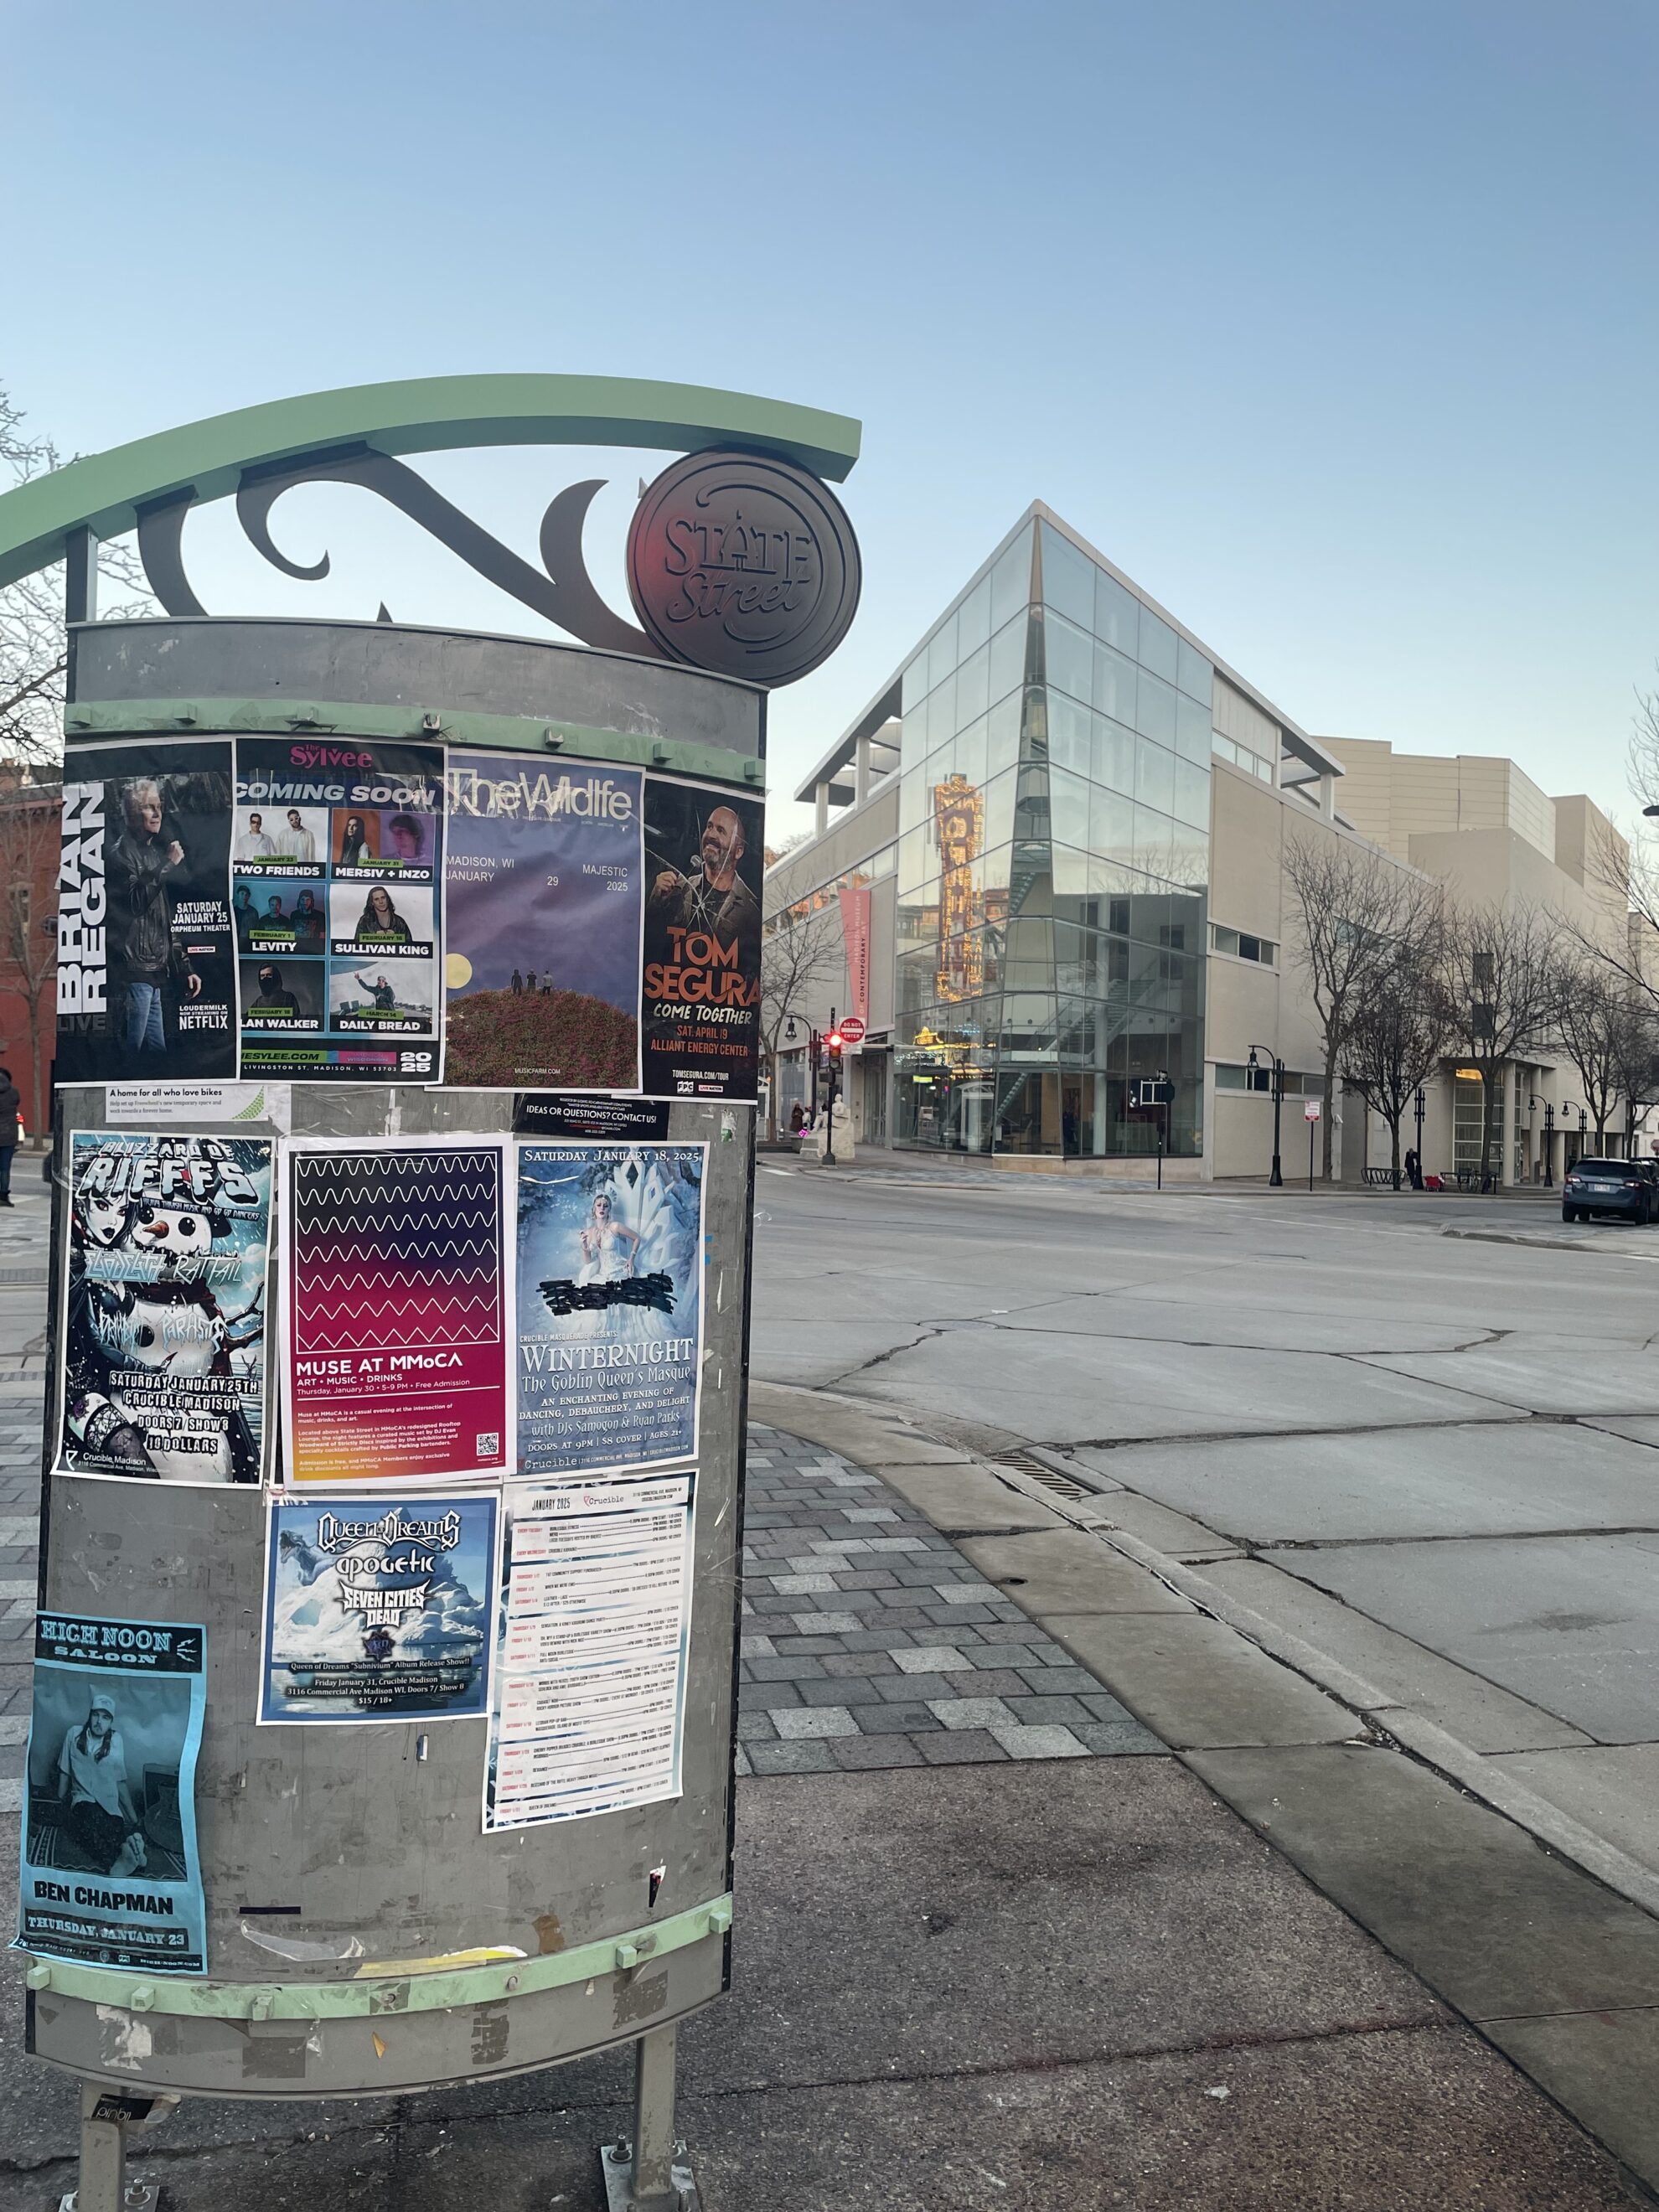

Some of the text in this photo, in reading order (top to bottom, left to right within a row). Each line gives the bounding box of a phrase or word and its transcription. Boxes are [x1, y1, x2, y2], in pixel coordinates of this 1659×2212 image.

[664, 510, 812, 585] STATE
[666, 573, 798, 623] Street
[290, 745, 373, 768] Sylvee
[236, 782, 436, 805] COMING SOON
[447, 855, 514, 868] MADISON, WI
[233, 866, 319, 876] TWO FRIENDS
[335, 868, 385, 877] MERSIV
[399, 870, 430, 879] INZO
[447, 871, 494, 882] JANUARY
[583, 865, 628, 877] MAJESTIC
[547, 876, 559, 886] 29
[607, 881, 628, 892] 2025
[57, 784, 81, 1014] BRIAN
[80, 783, 106, 1013] REGAN
[177, 902, 222, 913] SATURDAY
[172, 912, 228, 924] JANUARY 25
[252, 942, 297, 951] LEVITY
[335, 944, 429, 954] SULLIVAN KING
[667, 927, 738, 969] TOM
[644, 964, 760, 1006] SEGURA
[654, 1003, 752, 1024] COME TOGETHER
[57, 1014, 106, 1032] LIVE
[179, 1016, 228, 1030] NETFLIX
[240, 1019, 318, 1028] LAN WALKER
[340, 1021, 420, 1031] DAILY BREAD
[677, 1026, 727, 1039] SAT. APRIL 19
[401, 1052, 432, 1062] 20
[651, 1039, 747, 1057] ALLIANT ENERGY CENTER
[401, 1062, 431, 1072] 25
[672, 1070, 729, 1081] TOMSEGURA.COM/TOUR
[526, 1105, 657, 1123] IDEAS OR QUESTIONS? CONTACT US!
[99, 1142, 234, 1160] BLIZZARD OF
[525, 1150, 699, 1163] SATURDAY JANUARY 18, 2025
[520, 1338, 694, 1372] WINTERNIGHT
[297, 1360, 352, 1376] MUSE
[359, 1358, 383, 1372] AT
[111, 1372, 257, 1393] SATURDAY JANUARY 25TH
[327, 1377, 357, 1385] MUSIC
[367, 1374, 402, 1382] DRINKS
[522, 1366, 690, 1394] The Goblin Queen's Masque
[125, 1392, 240, 1411] CRUCIBLE MADISON
[541, 1398, 555, 1407] AN
[560, 1393, 618, 1406] ENCHANTING
[623, 1389, 659, 1400] EVENING
[519, 1396, 690, 1420] DANCING, DEBAUCHERY, AND DELIGHT
[532, 1411, 680, 1436] with DJs Samogon & Ryan Parks
[148, 1437, 217, 1452] 10 DOLLARS
[528, 1443, 557, 1452] DOORS
[561, 1441, 572, 1450] AT
[576, 1439, 593, 1450] 9PM
[602, 1436, 612, 1445] $8
[616, 1434, 642, 1444] COVER
[649, 1430, 668, 1439] AGES
[83, 1453, 146, 1465] Crucible Madison
[525, 1457, 577, 1470] Crucible
[532, 1497, 571, 1511] JANUARY 2025
[589, 1496, 623, 1505] Crucible
[318, 1510, 461, 1553] QUEEN DREAMS
[342, 1584, 427, 1612] SEVEN CITIES
[363, 1610, 406, 1629] DEAD
[41, 1620, 173, 1652] HIGH NOON
[54, 1646, 158, 1664] SALOON
[315, 1679, 337, 1687] Friday
[339, 1679, 364, 1687] January
[34, 1881, 173, 1915] BEN CHAPMAN
[28, 1917, 184, 1946] THURSDAY, JANUARY 23
